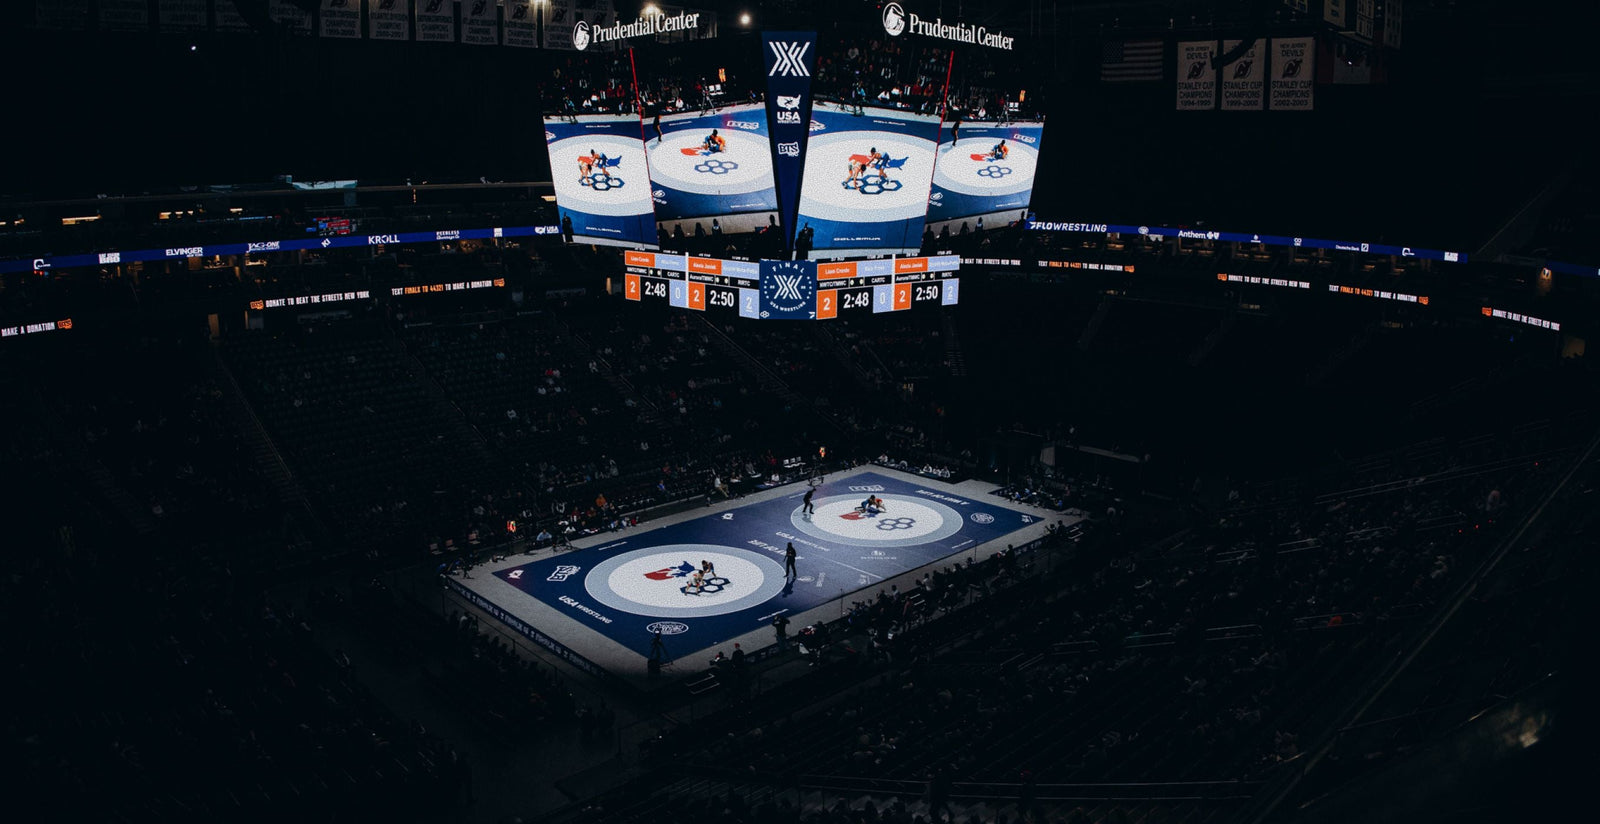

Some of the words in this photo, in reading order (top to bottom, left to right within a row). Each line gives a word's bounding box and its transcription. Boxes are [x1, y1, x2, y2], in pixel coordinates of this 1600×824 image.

[593, 15, 654, 43] Prudential
[656, 10, 699, 32] Center
[909, 13, 976, 43] Prudential
[978, 26, 1014, 50] Center
[1179, 81, 1201, 89] STANLEY
[1272, 81, 1298, 89] STANLEY
[777, 112, 800, 120] USA
[779, 143, 799, 154] BTS
[1036, 222, 1107, 232] FLOWRESTLING
[368, 235, 400, 244] KROLL
[1178, 230, 1206, 239] Anthem
[166, 247, 203, 256] ELVINGER
[772, 262, 804, 273] FINAL
[630, 281, 635, 293] 2
[645, 282, 666, 297] 2:48
[676, 287, 680, 299] 0
[900, 290, 906, 302] 2
[916, 286, 938, 301] 2:50
[948, 286, 953, 298] 2
[266, 298, 285, 308] DONATE
[296, 296, 308, 305] BEAT
[322, 293, 342, 302] STREETS
[694, 290, 699, 302] 2
[710, 290, 734, 307] 2:50
[746, 297, 752, 310] 2
[824, 298, 830, 311] 2
[843, 292, 869, 308] 2:48
[880, 292, 885, 304] 0
[1397, 294, 1417, 302] DONATION
[770, 301, 778, 309] USA
[780, 301, 806, 312] WRESTLING
[1, 326, 18, 337] MAKE
[20, 326, 25, 334] A
[27, 322, 55, 333] DONATION
[558, 596, 579, 607] USA
[576, 604, 613, 624] WRESTLING
